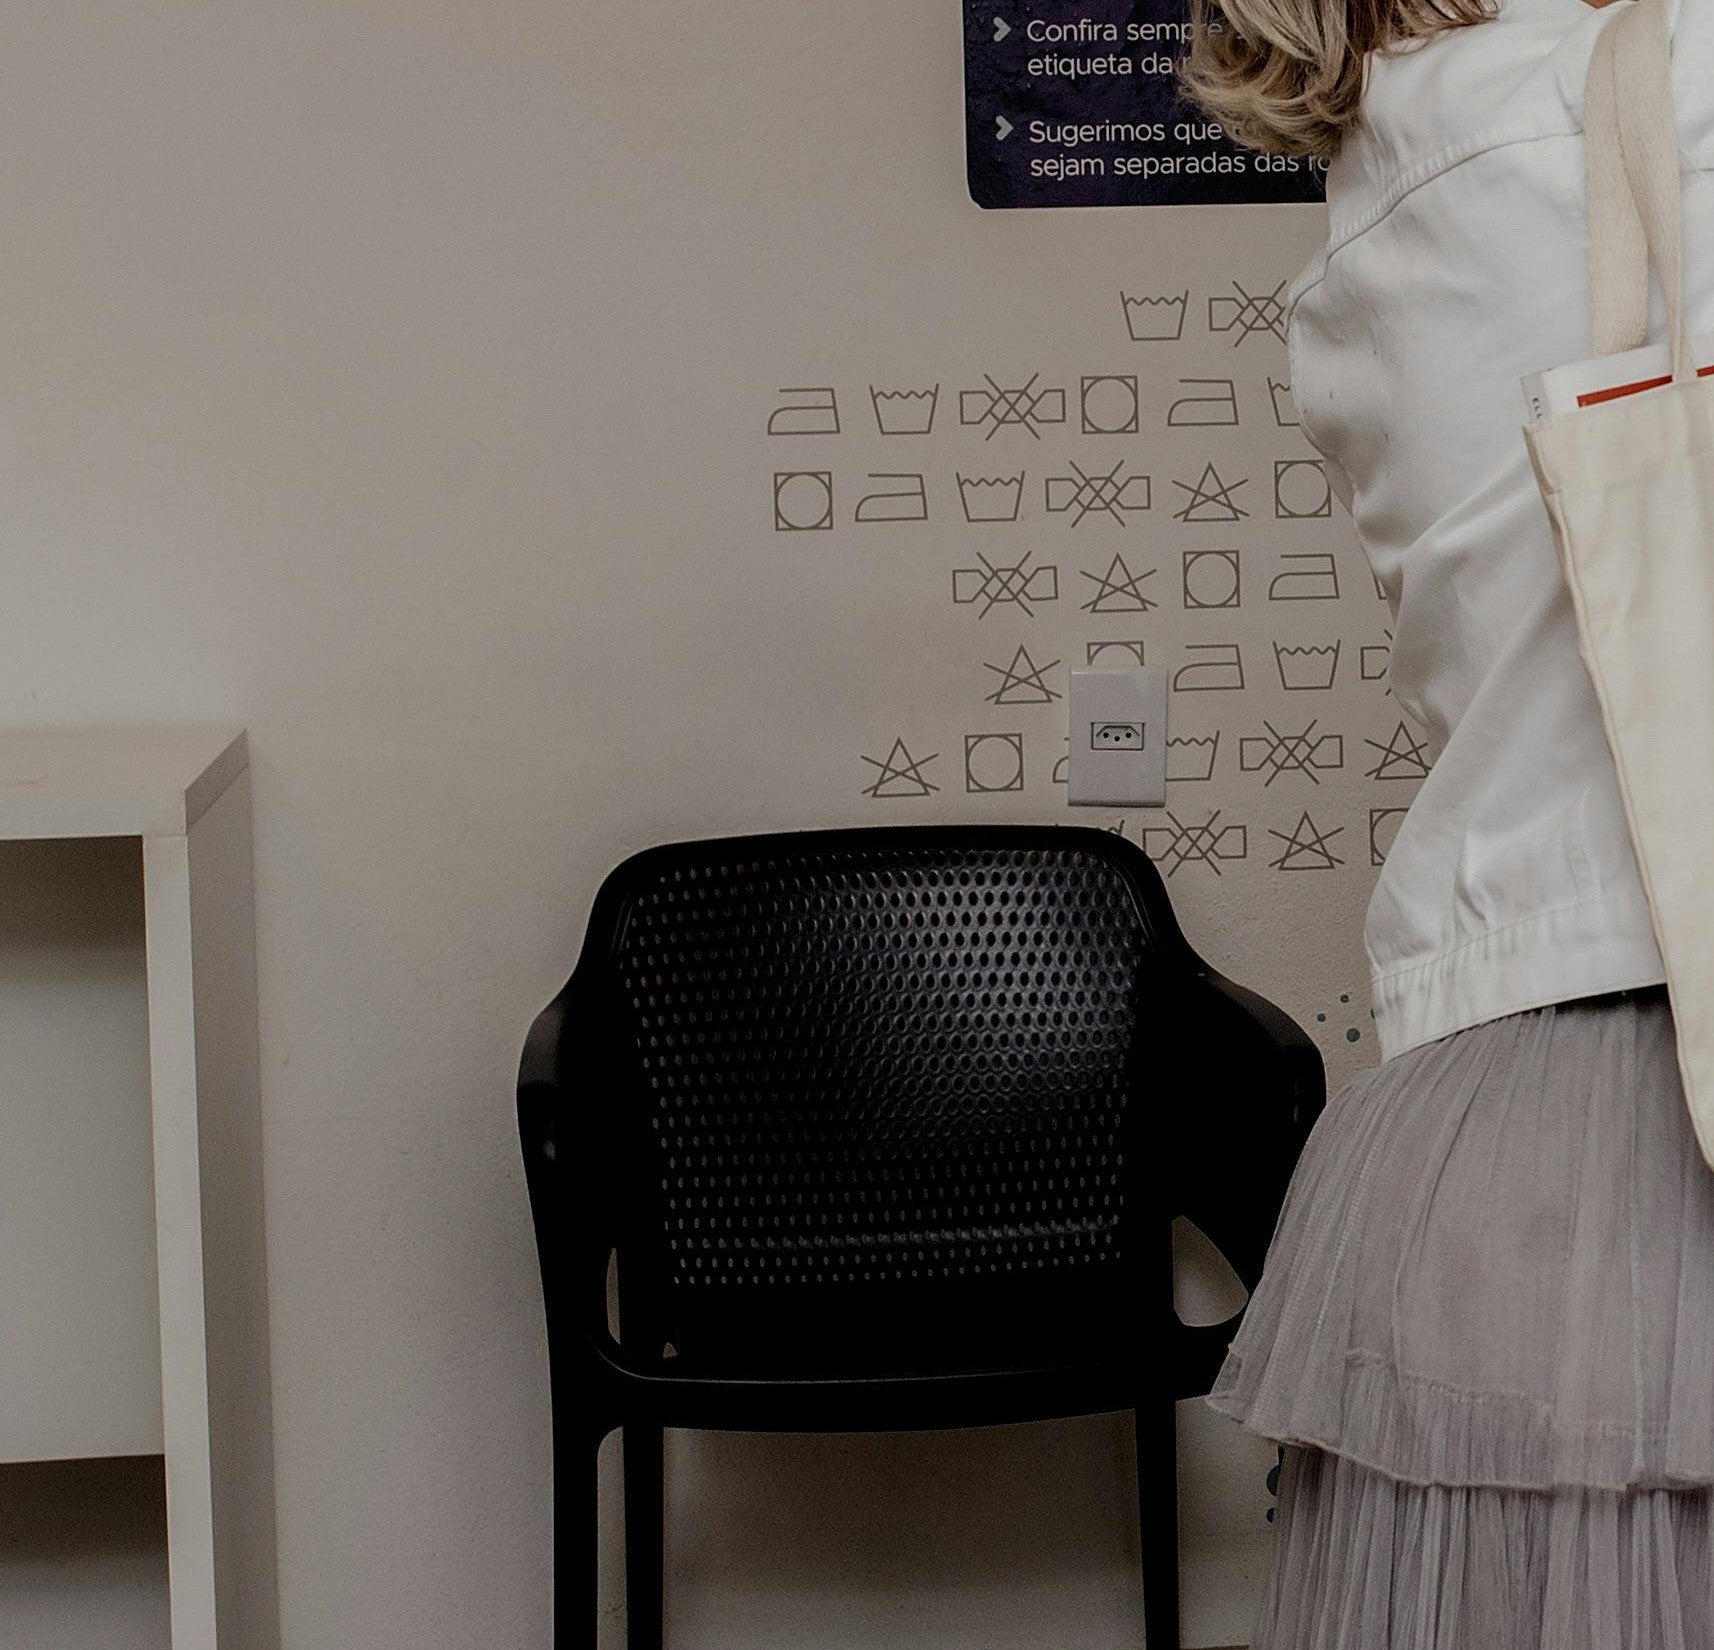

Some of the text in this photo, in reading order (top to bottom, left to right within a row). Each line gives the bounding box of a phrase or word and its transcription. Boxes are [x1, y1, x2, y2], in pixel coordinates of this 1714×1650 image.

[1027, 19, 1117, 42] Confira
[1028, 53, 1132, 80] etiqueta
[1141, 52, 1173, 74] da
[1029, 119, 1221, 150] Sugerimos que
[1030, 155, 1104, 180] sejam
[1114, 152, 1245, 178] separadas
[1255, 150, 1299, 171] das
